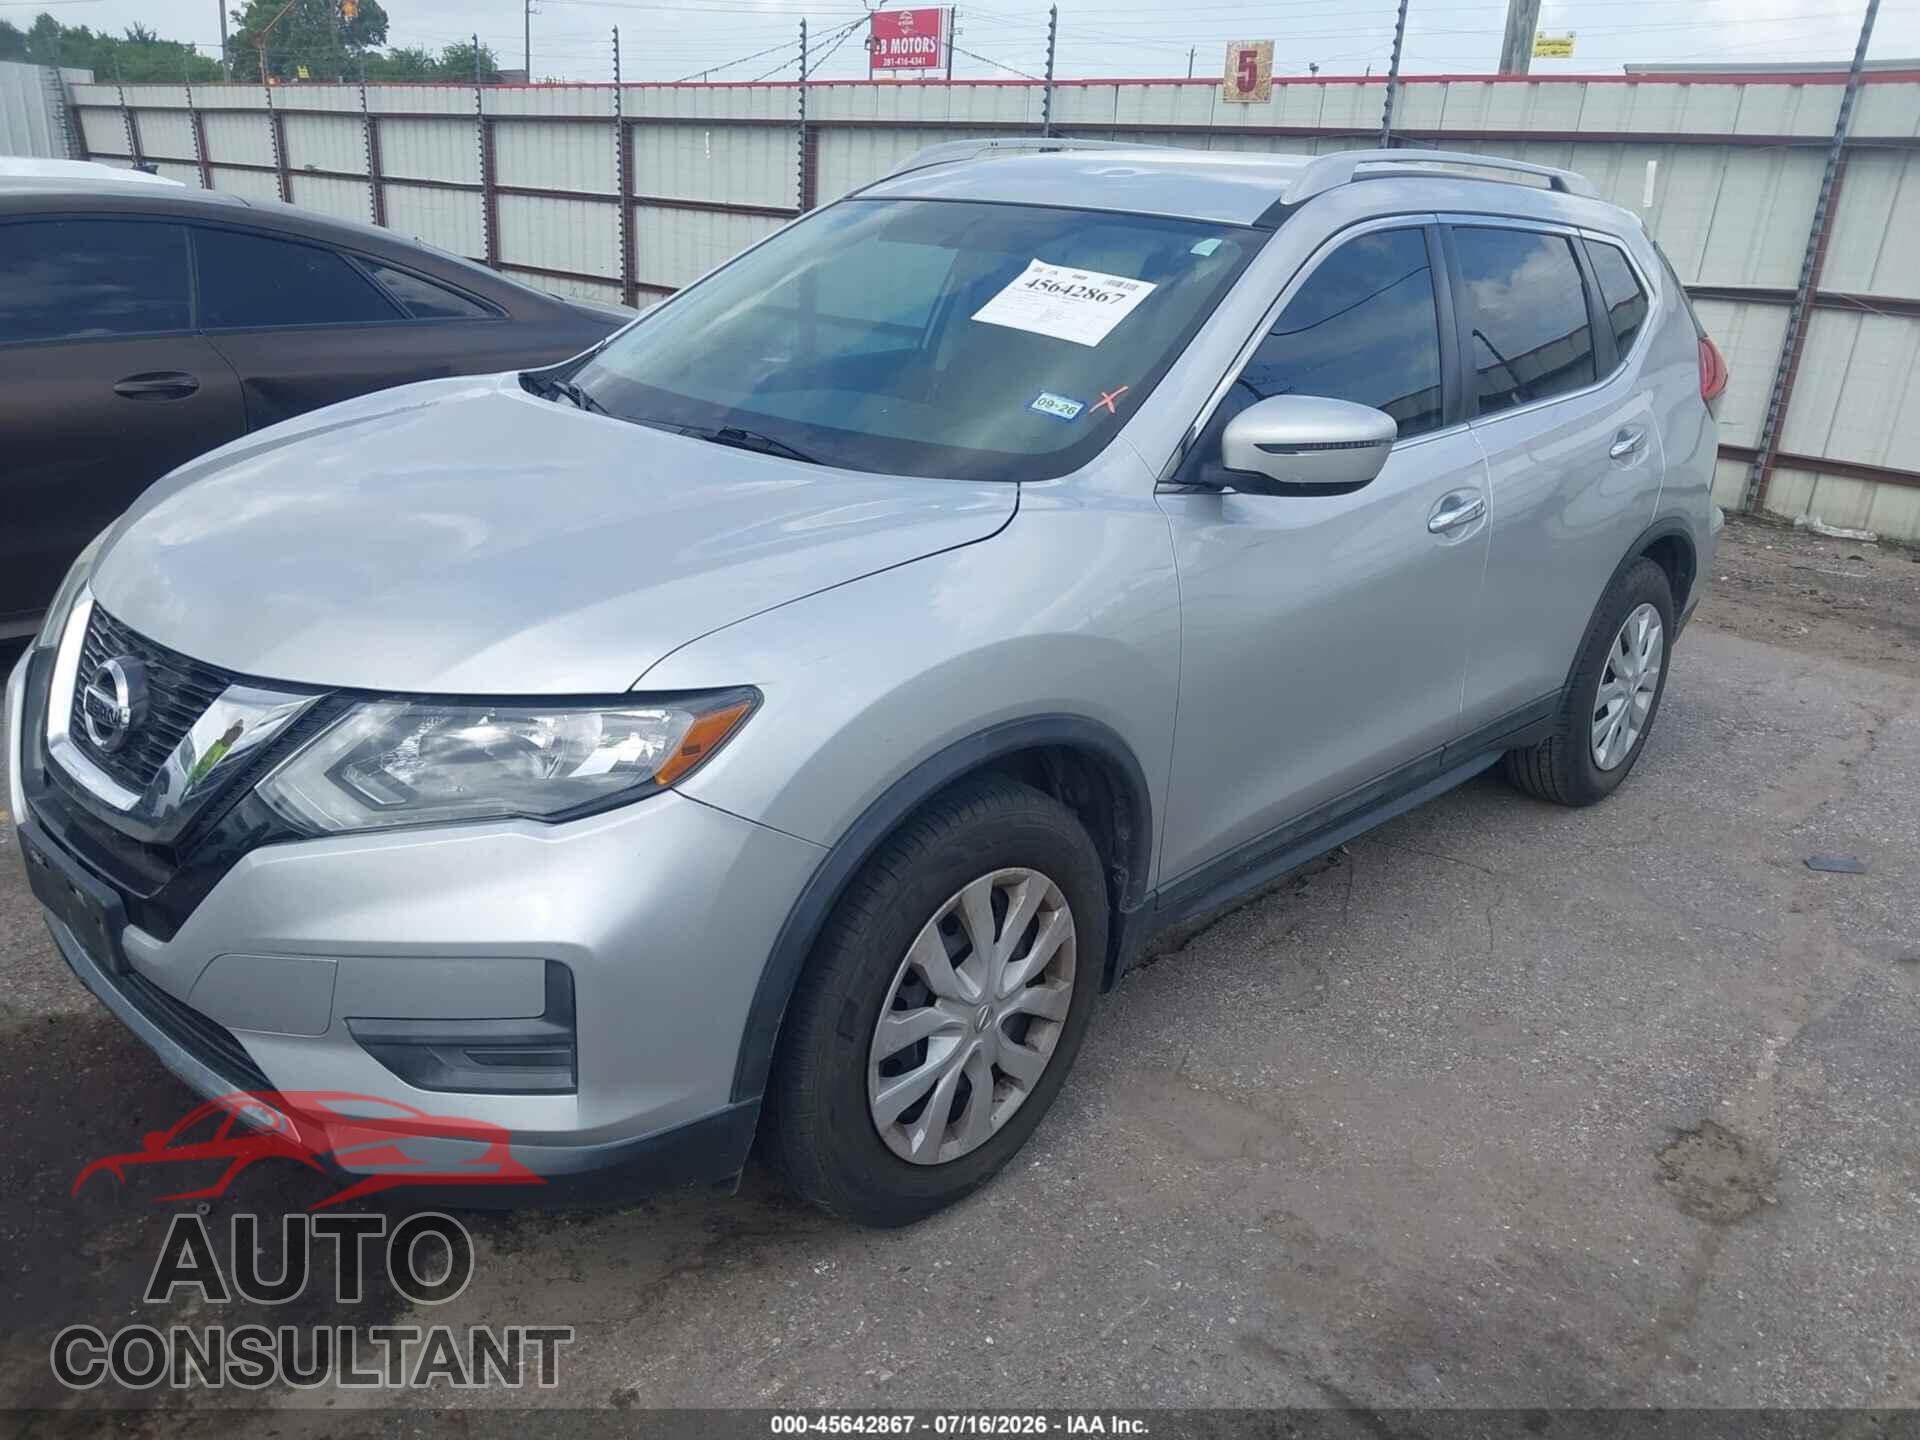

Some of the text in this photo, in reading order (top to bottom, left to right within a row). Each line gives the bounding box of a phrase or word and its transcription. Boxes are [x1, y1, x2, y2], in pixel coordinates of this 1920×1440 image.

[891, 36, 936, 54] MOTORS
[1236, 50, 1258, 93] 5
[1024, 278, 1127, 304] 45642867
[1037, 398, 1078, 415] 09-26
